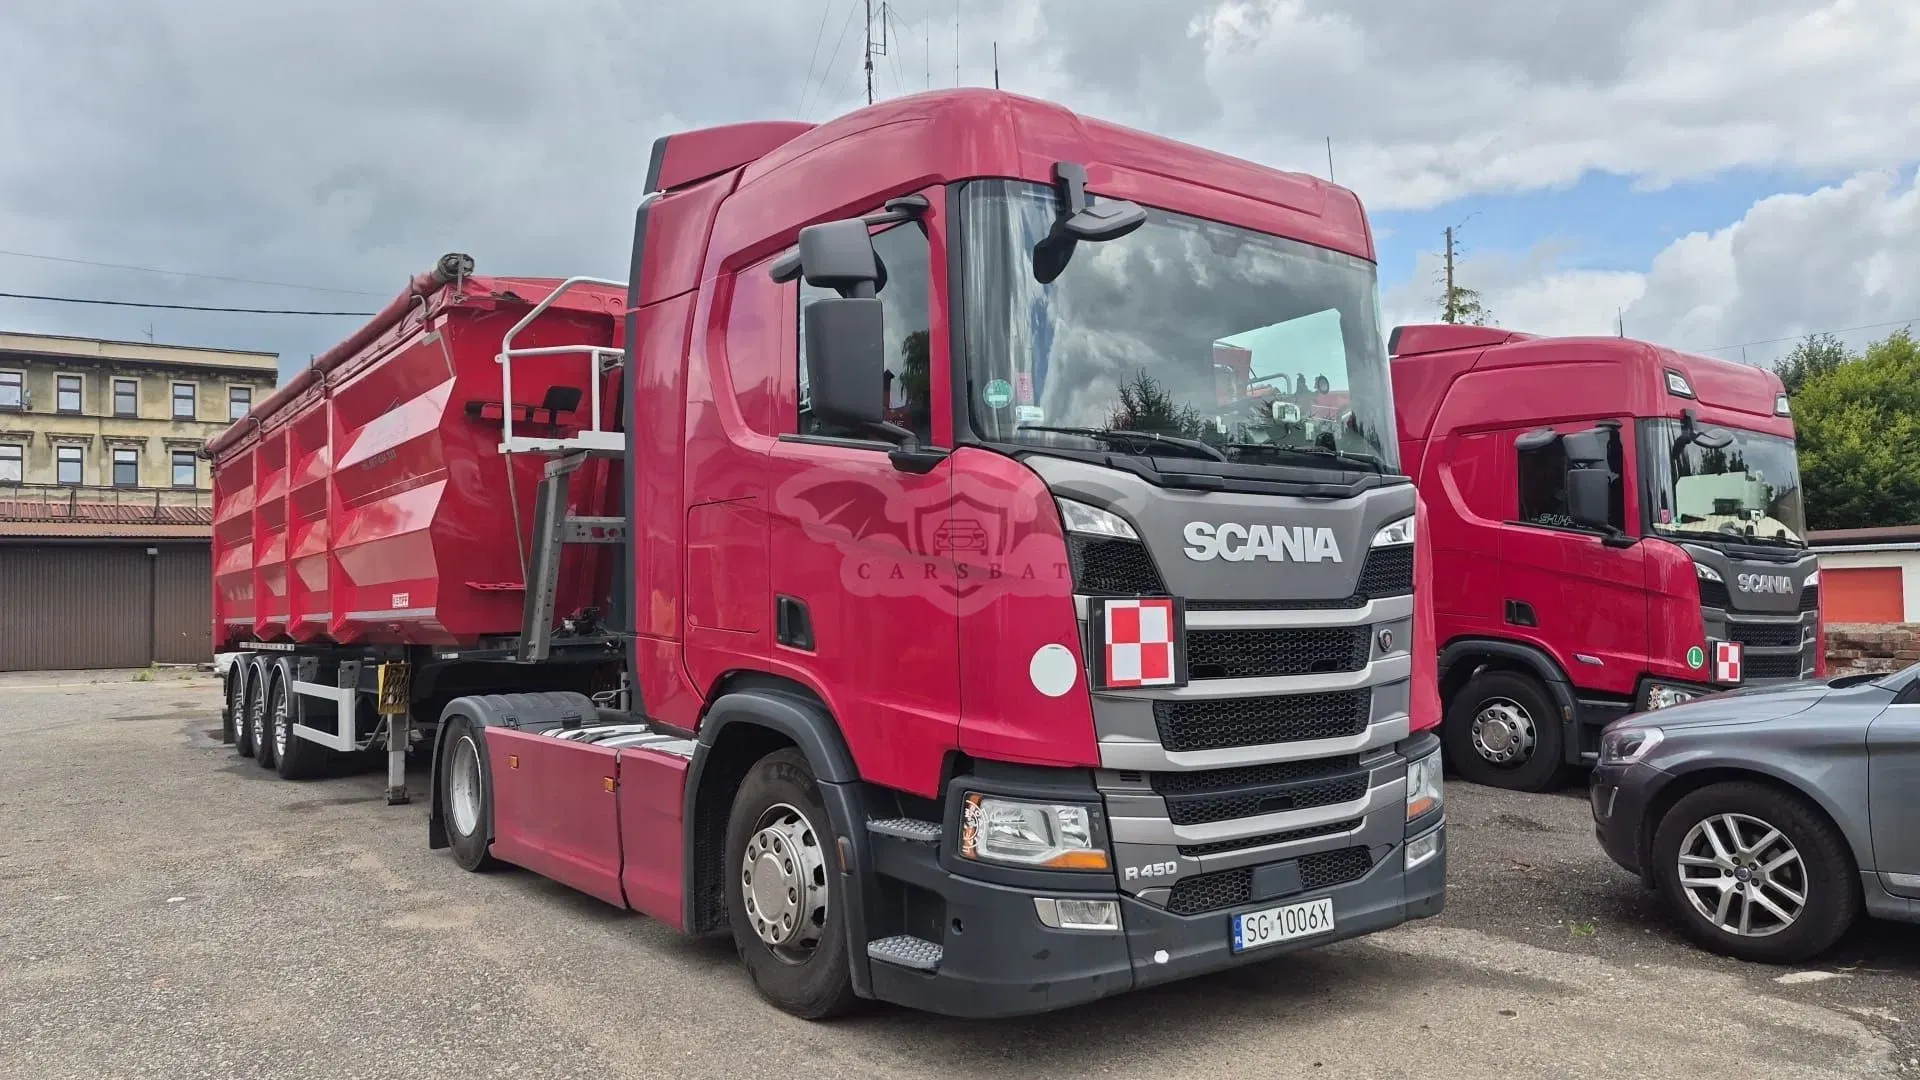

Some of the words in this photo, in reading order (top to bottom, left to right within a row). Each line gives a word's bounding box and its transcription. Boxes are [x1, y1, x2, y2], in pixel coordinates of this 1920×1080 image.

[1183, 521, 1343, 563] SCANIA
[1738, 573, 1794, 594] SCANIA
[1692, 649, 1700, 665] L
[1125, 866, 1138, 880] R
[1141, 861, 1177, 879] 450
[1246, 914, 1269, 943] SG
[1276, 902, 1330, 936] 1006X
